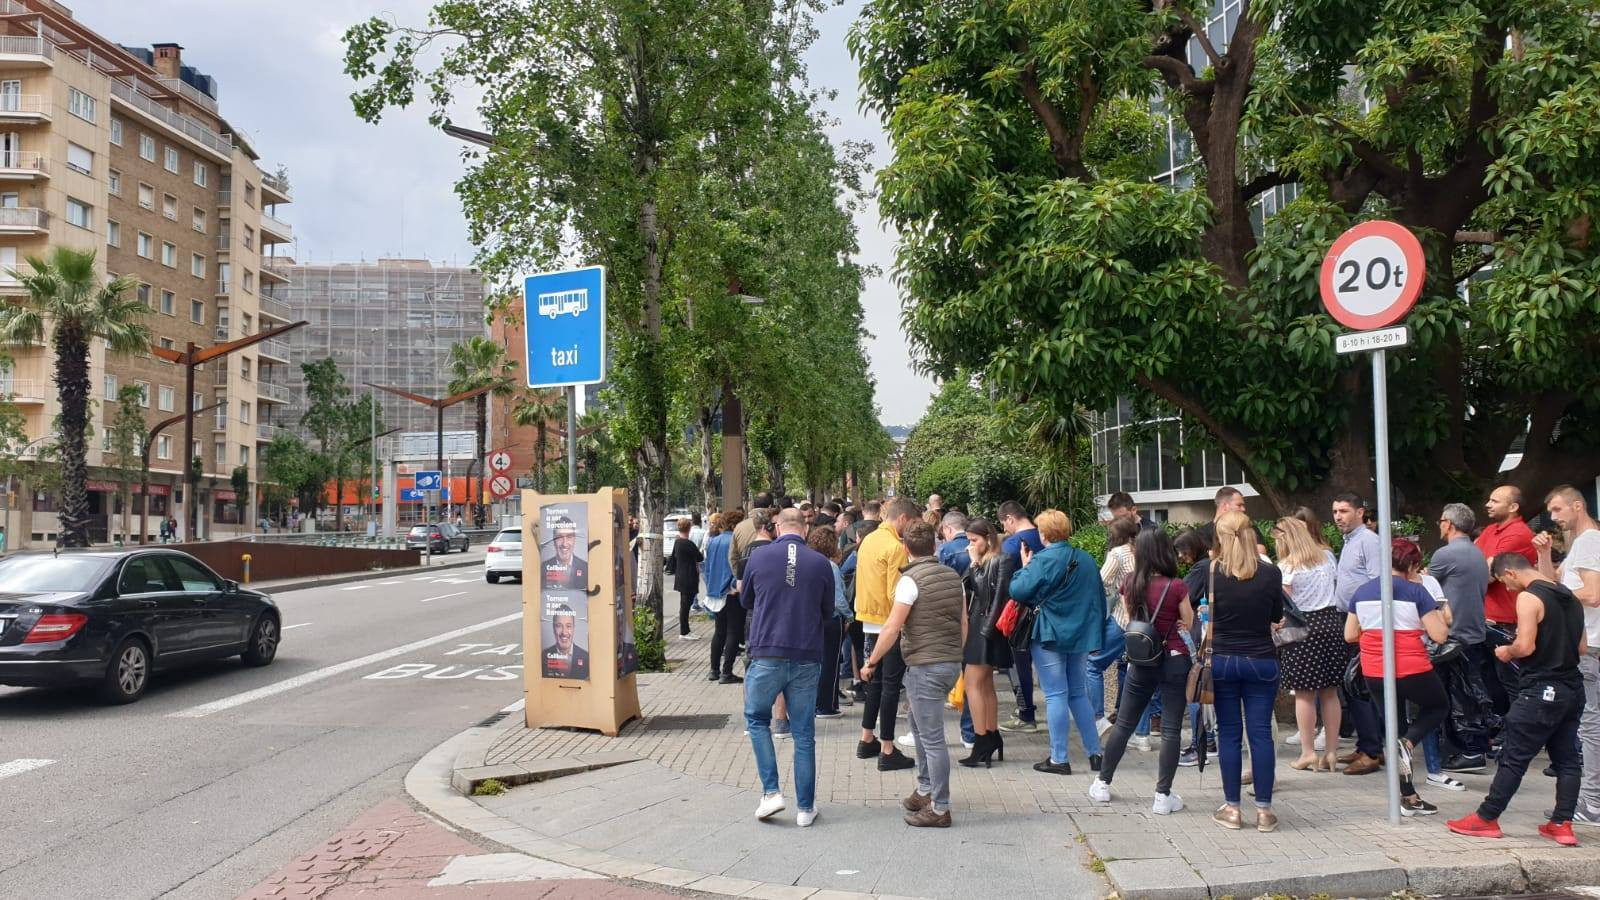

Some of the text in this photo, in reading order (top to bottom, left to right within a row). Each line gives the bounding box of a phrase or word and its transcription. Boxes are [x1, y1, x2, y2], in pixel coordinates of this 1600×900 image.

[1339, 257, 1403, 292] 20t
[1342, 339, 1358, 348] 8-10
[1360, 337, 1365, 345] h
[1372, 334, 1393, 343] 18-20
[551, 344, 578, 367] taxi
[546, 521, 577, 529] Barcelona
[546, 608, 577, 616] Barcelona
[443, 643, 525, 656] TA
[361, 663, 525, 681] BUS
